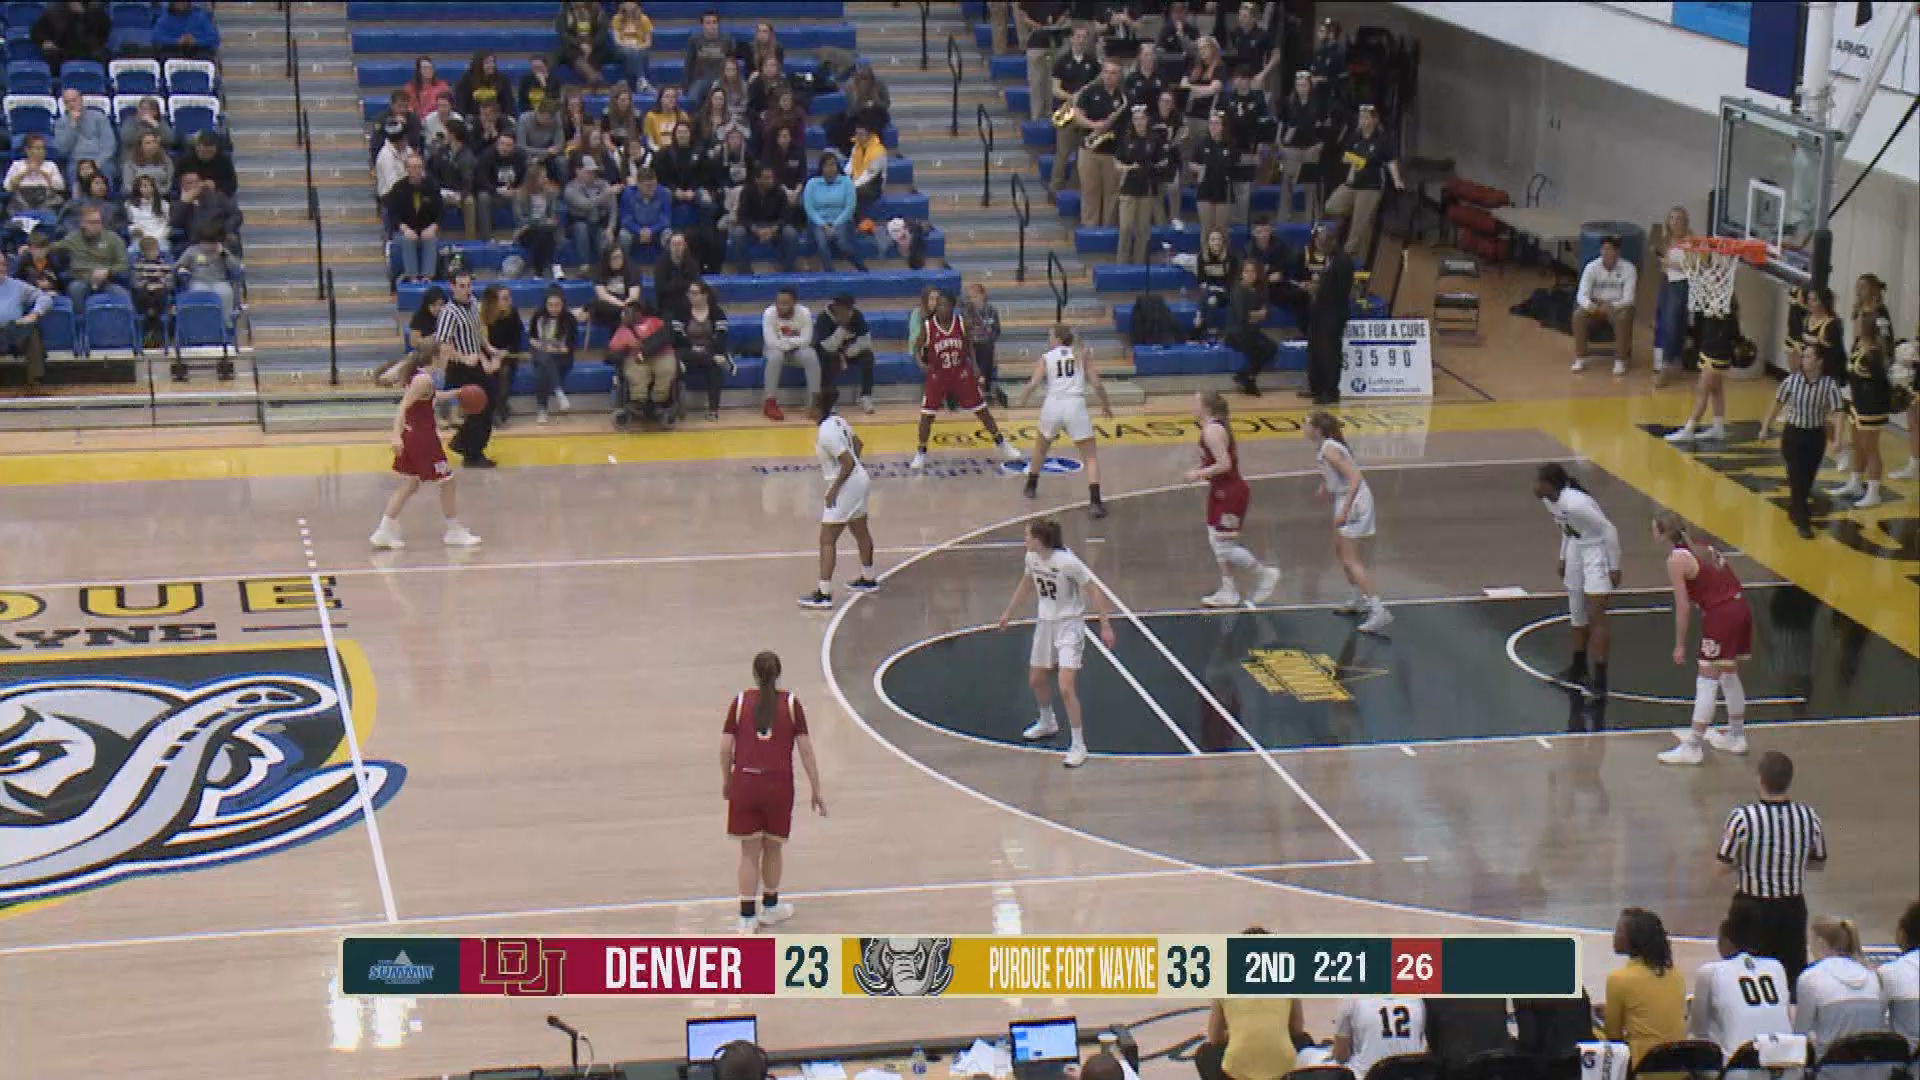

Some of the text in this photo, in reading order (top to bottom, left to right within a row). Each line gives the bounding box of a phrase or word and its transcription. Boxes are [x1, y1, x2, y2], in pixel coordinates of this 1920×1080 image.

[1368, 323, 1387, 338] FOR
[1391, 323, 1398, 338] A
[1400, 323, 1426, 338] CURE
[1056, 360, 1075, 378] 10
[1036, 577, 1057, 601] 32
[1739, 974, 1780, 1006] 00
[1379, 1006, 1411, 1038] 12
